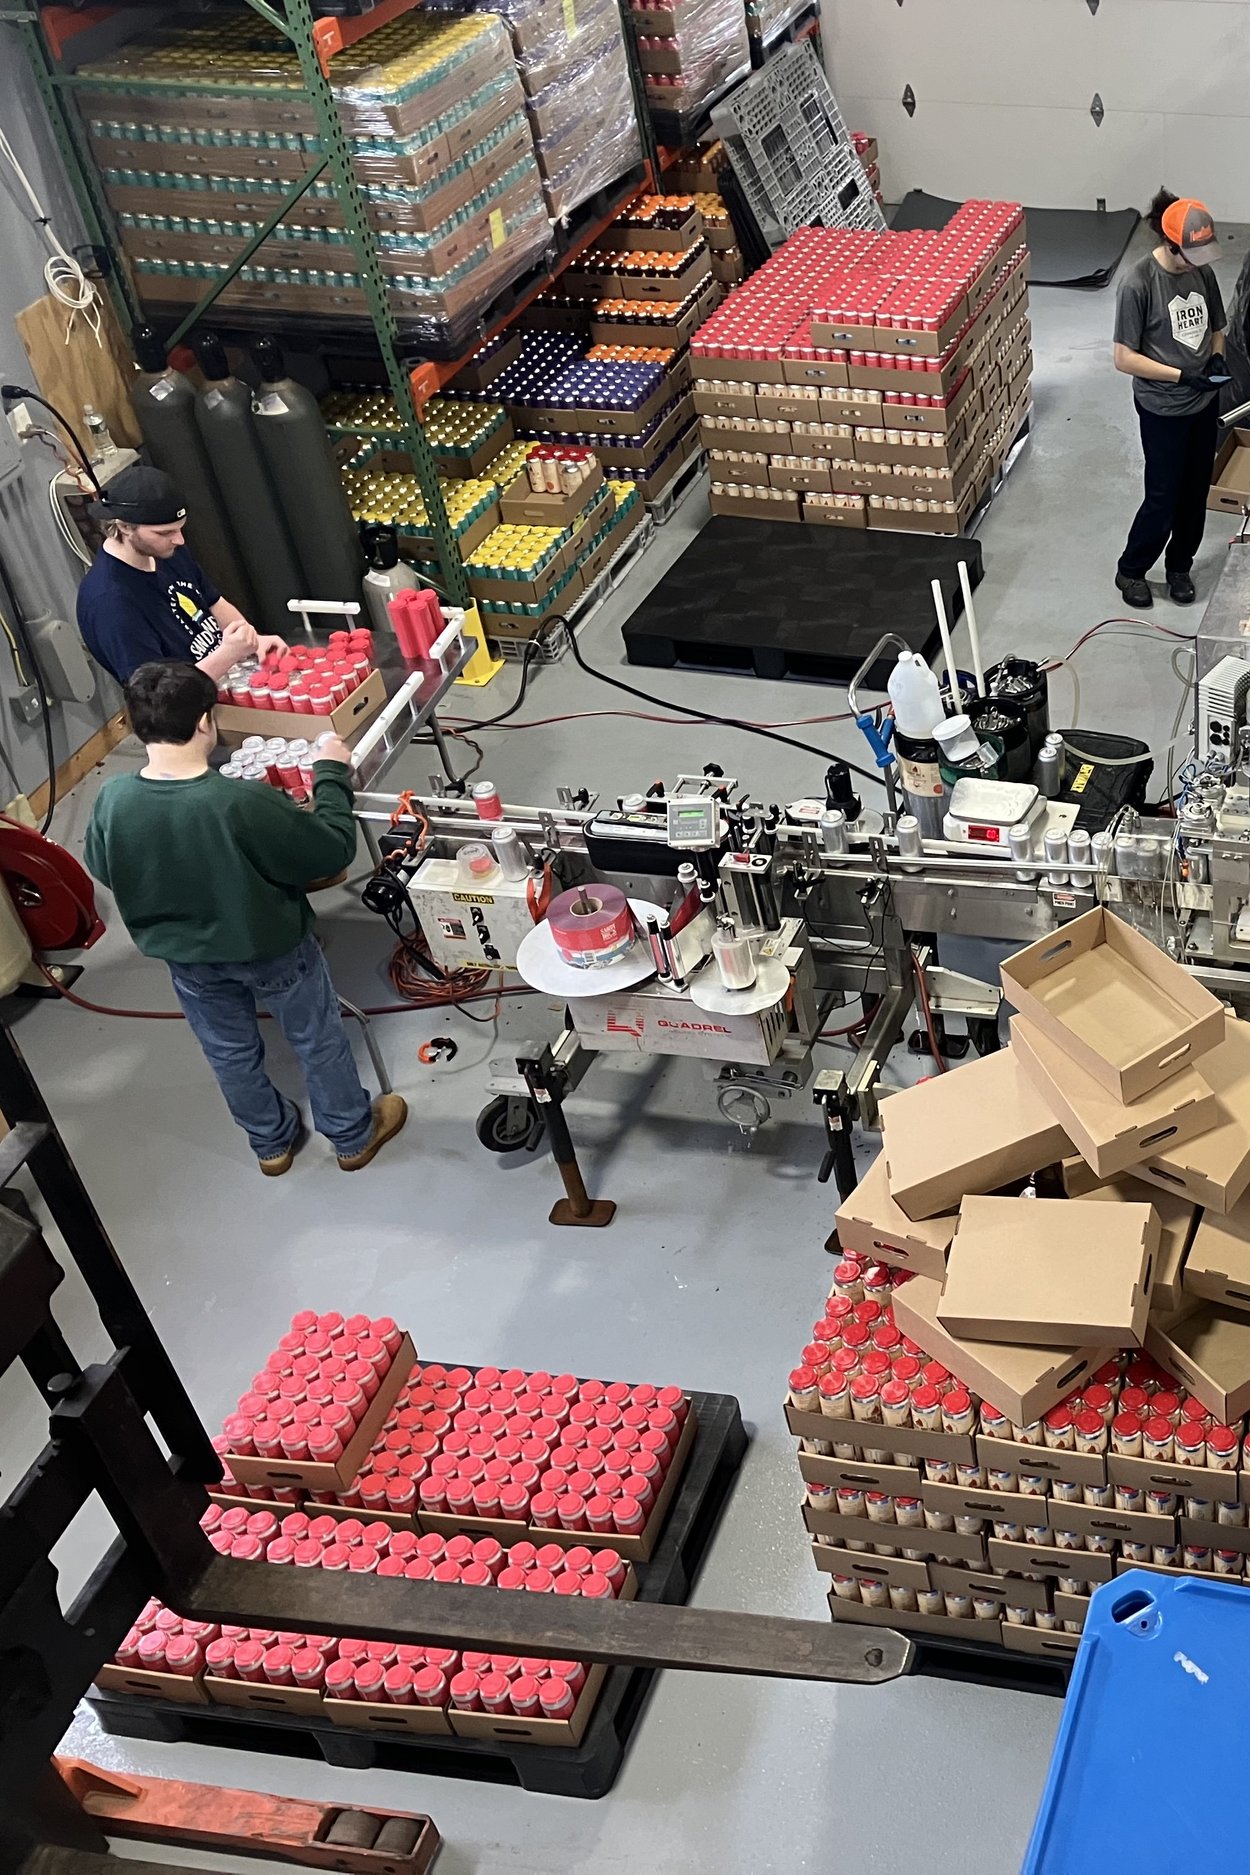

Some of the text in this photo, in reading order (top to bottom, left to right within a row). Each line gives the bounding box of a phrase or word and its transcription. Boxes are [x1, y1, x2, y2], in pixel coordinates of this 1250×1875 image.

[1176, 305, 1204, 321] IRON
[1178, 316, 1204, 330] HEART
[190, 629, 216, 661] SAND
[454, 893, 493, 904] CAUTION
[658, 1020, 732, 1033] QUADREL
